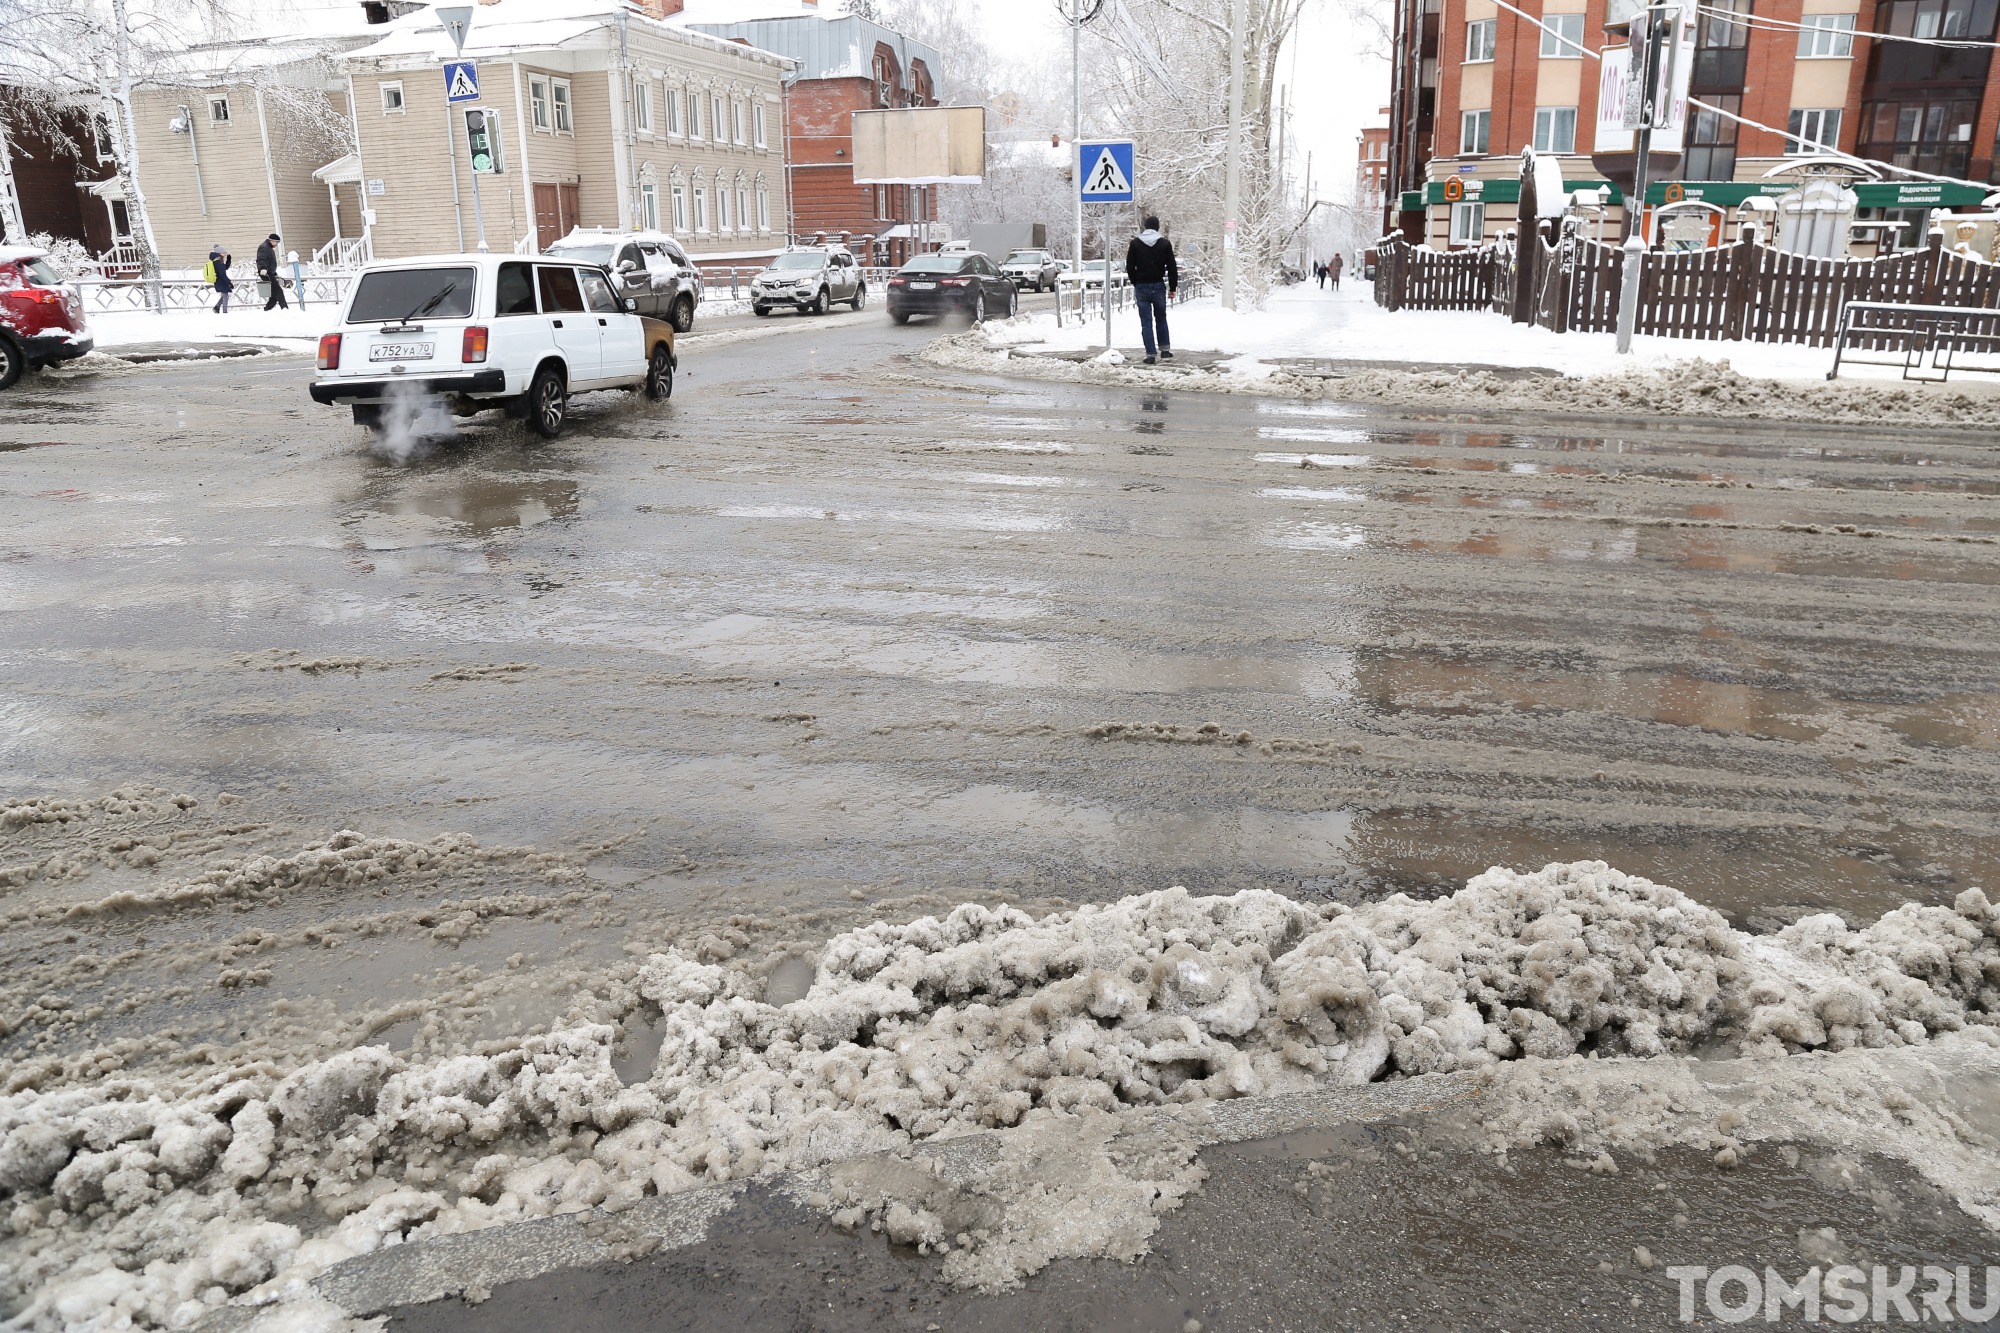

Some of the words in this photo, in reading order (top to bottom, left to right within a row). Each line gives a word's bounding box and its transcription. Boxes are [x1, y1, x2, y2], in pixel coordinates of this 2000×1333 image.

[1600, 65, 1625, 121] 100.9
[1463, 180, 1484, 190] ТЕПЛО
[1465, 193, 1480, 201] УЮТ
[1897, 195, 1941, 203] Канализация
